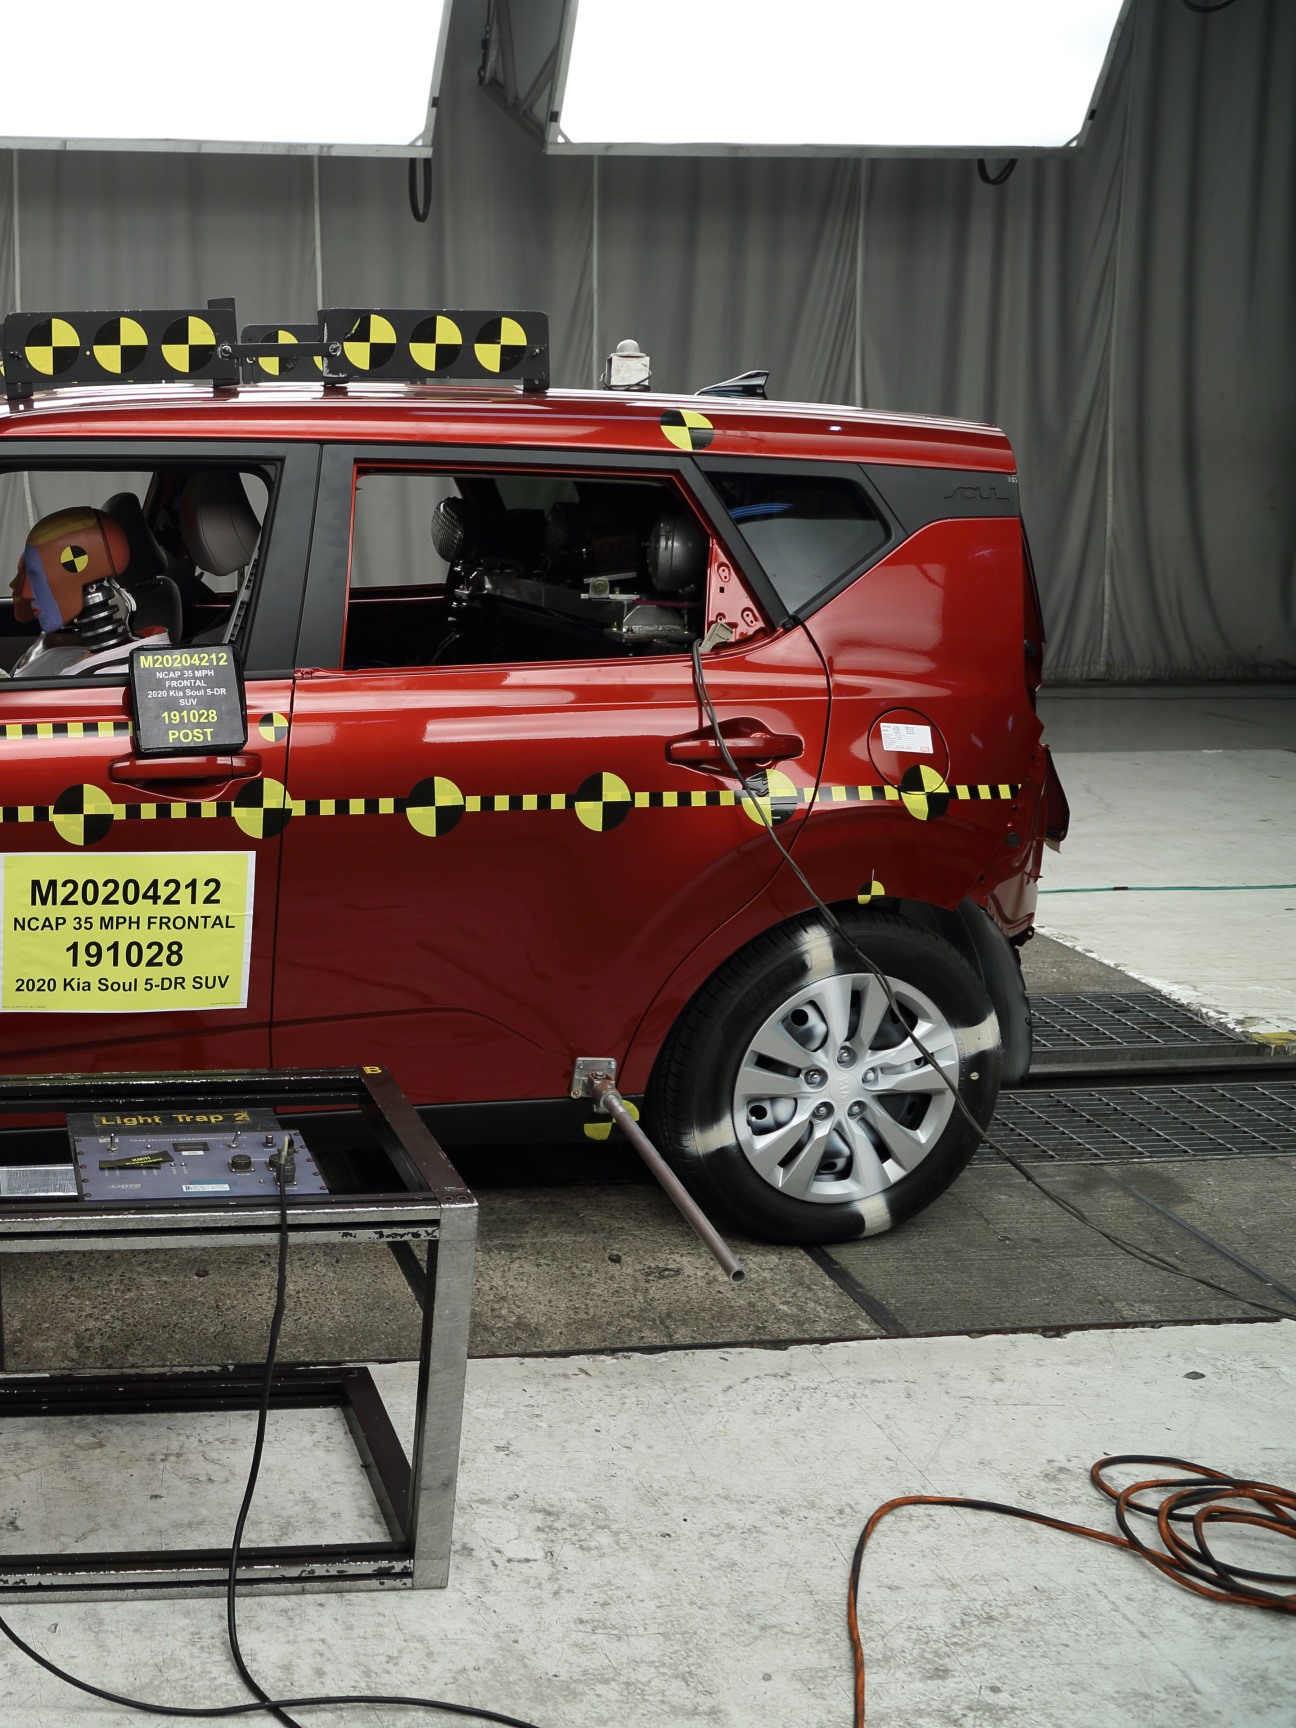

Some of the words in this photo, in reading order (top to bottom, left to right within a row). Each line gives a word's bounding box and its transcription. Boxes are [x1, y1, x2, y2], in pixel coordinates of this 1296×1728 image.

[139, 653, 228, 669] M20204212
[156, 671, 181, 679] NCAP
[183, 670, 193, 678] 35
[194, 669, 215, 677] MPH
[165, 680, 207, 688] FRONTAL
[147, 690, 168, 698] 2020
[169, 689, 183, 697] Kia
[185, 688, 204, 696] Soul
[206, 688, 227, 696] 5-DR
[179, 698, 198, 706] SUV
[162, 709, 218, 724] 191028
[168, 728, 214, 743] POST
[30, 877, 221, 907] M20204212
[13, 916, 67, 931] NCAP
[72, 916, 94, 931] 35
[99, 915, 141, 931] MPH
[147, 915, 236, 931] FRONTAL
[65, 940, 184, 968] 191028
[15, 978, 57, 992] 2020
[63, 977, 91, 992] Kia
[97, 977, 138, 992] Soul
[143, 976, 186, 992] 5-DR
[192, 975, 230, 990] SUV
[101, 1115, 162, 1126] Light
[175, 1113, 224, 1124] Trap
[234, 1112, 249, 1123] 2
